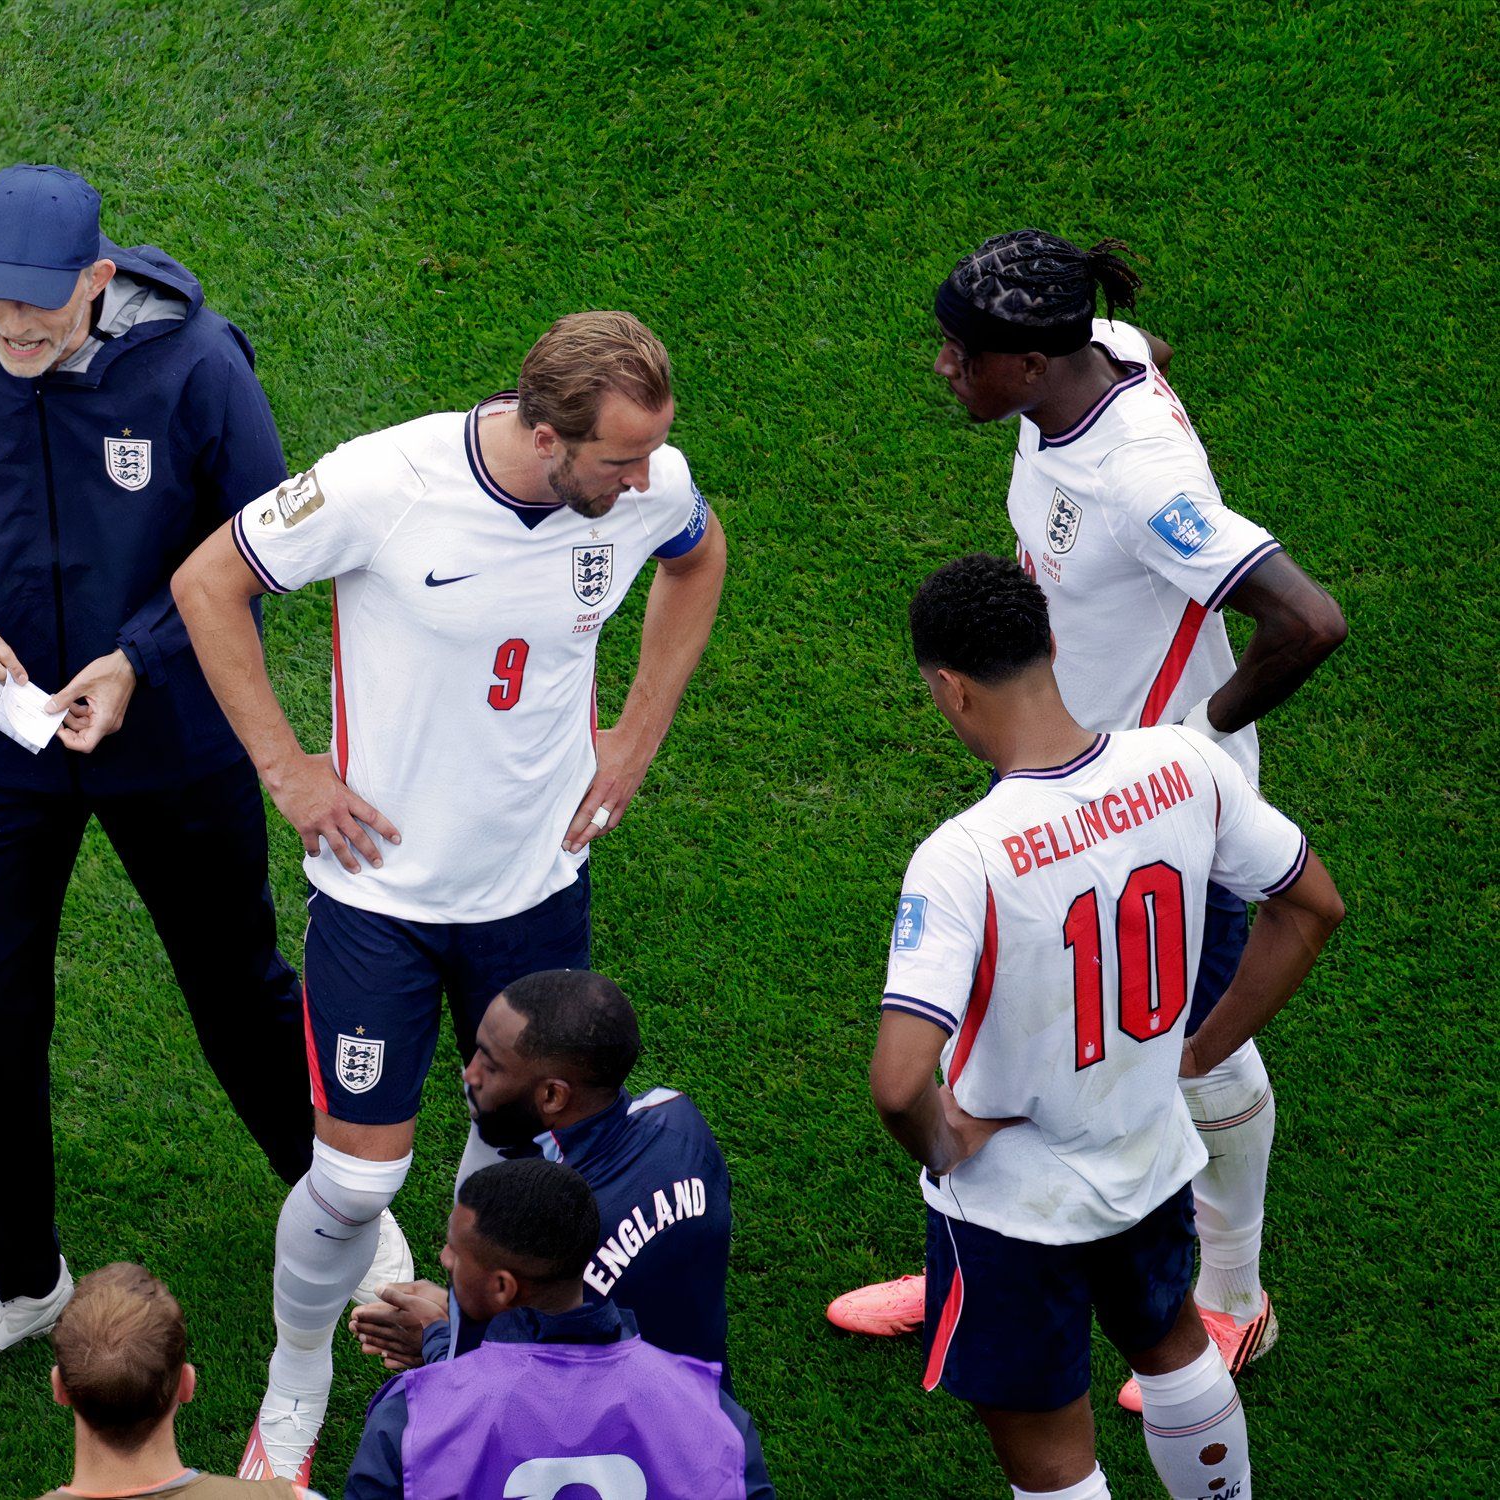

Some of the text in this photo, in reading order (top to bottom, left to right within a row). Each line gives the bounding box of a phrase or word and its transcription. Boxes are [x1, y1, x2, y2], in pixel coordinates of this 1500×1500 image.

[486, 638, 530, 711] 9
[1001, 760, 1195, 878] BELLINGHAM
[1062, 859, 1188, 1073] 10
[582, 1177, 707, 1297] ENGLAND
